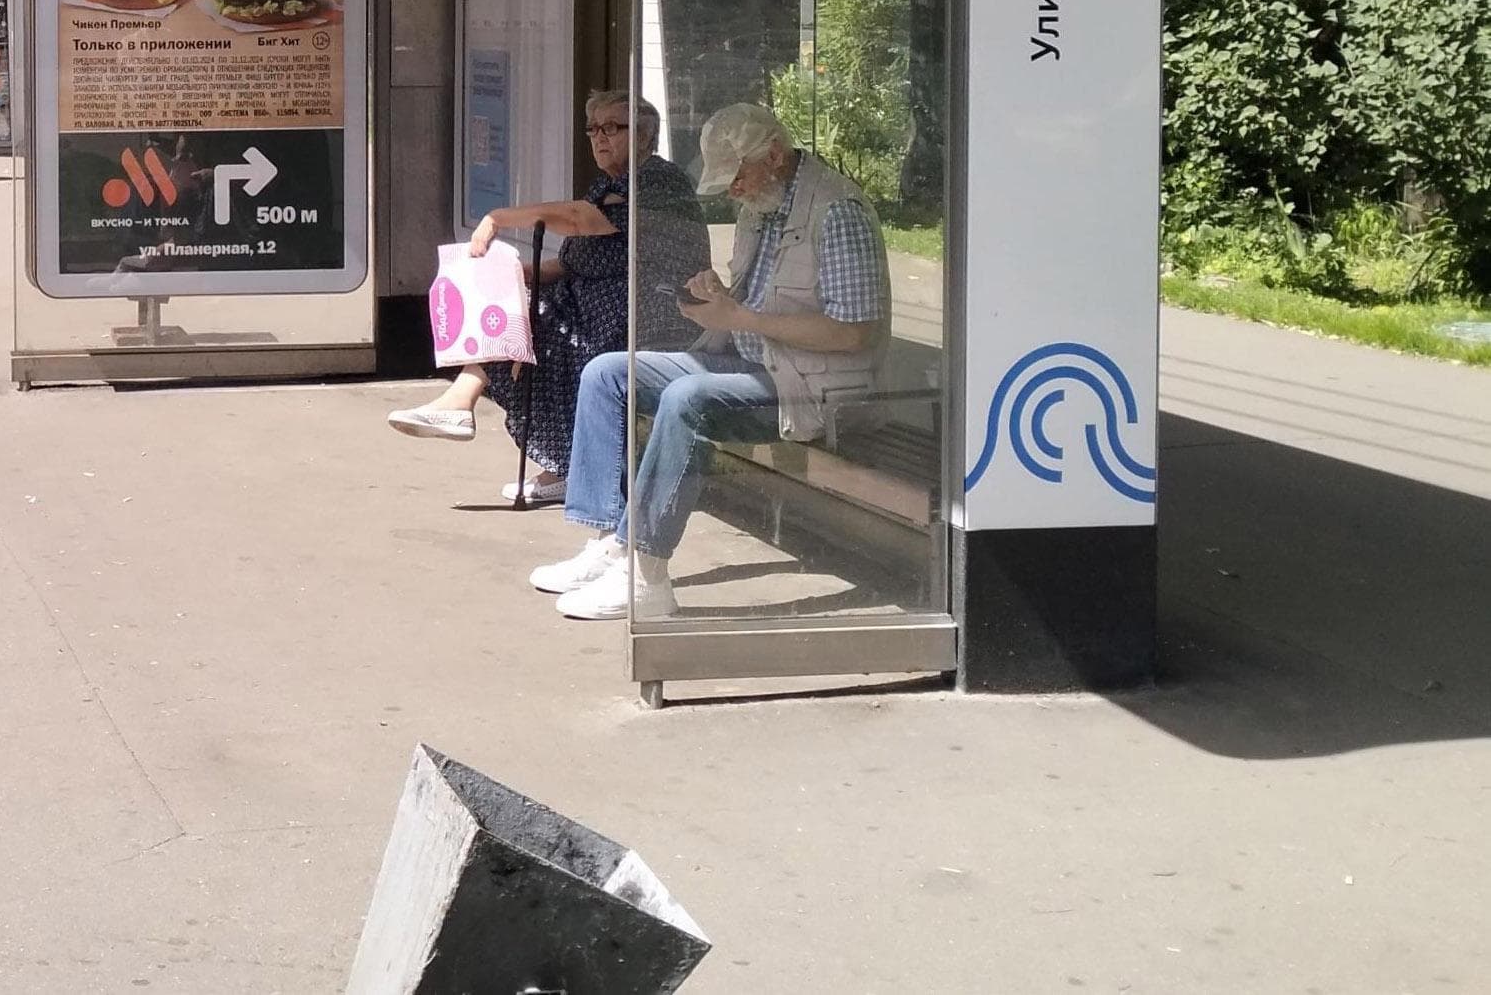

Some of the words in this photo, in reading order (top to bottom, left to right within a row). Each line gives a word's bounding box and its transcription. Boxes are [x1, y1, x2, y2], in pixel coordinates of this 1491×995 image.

[72, 19, 108, 30] Чикен
[110, 19, 162, 31] Премьер
[72, 39, 123, 51] Только
[127, 41, 136, 51] в
[140, 39, 232, 53] приложении
[257, 37, 278, 47] Биг
[280, 37, 301, 47] Хит
[256, 206, 296, 224] 500
[300, 208, 318, 224] м
[91, 218, 133, 228] ВКУСНО
[144, 217, 152, 227] И
[155, 217, 190, 227] ТОЧКА
[139, 245, 161, 259] ул.
[164, 242, 254, 258] Планерная,
[257, 241, 277, 254] 12
